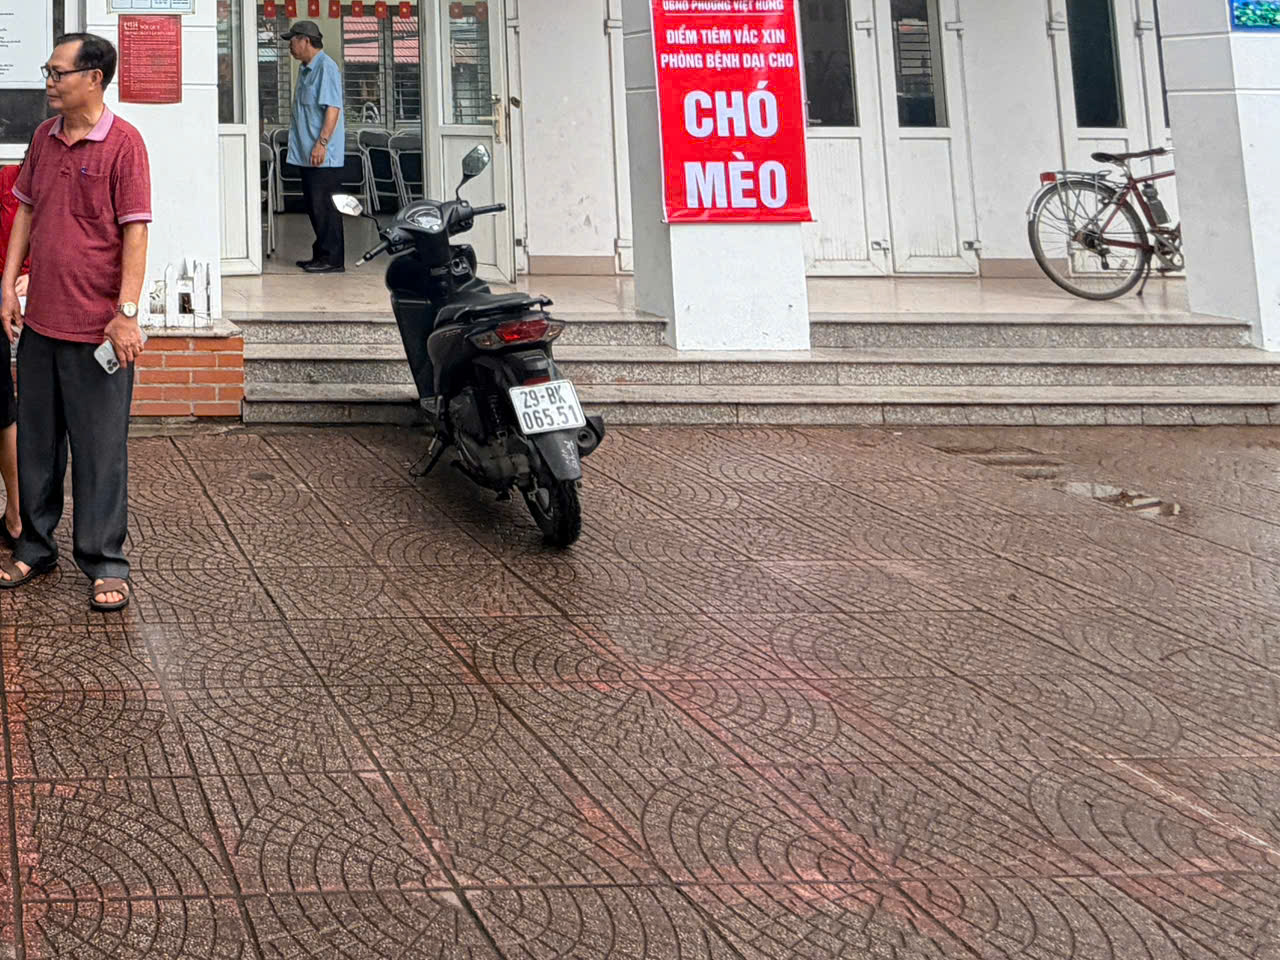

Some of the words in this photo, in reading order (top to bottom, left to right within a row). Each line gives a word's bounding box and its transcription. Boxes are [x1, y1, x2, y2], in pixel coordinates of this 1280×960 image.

[666, 24, 697, 44] ĐIỂM
[700, 26, 731, 44] TIÊM
[734, 24, 759, 44] VẮC
[761, 29, 786, 44] XIN
[660, 50, 703, 68] PHÒNG
[706, 50, 740, 71] BỆNH
[743, 52, 765, 71] DẠI
[768, 52, 794, 68] CHO
[684, 80, 778, 138] CHÓ
[684, 152, 788, 209] MÈO
[520, 385, 566, 409] 29-BK
[522, 404, 579, 430] 065.51
